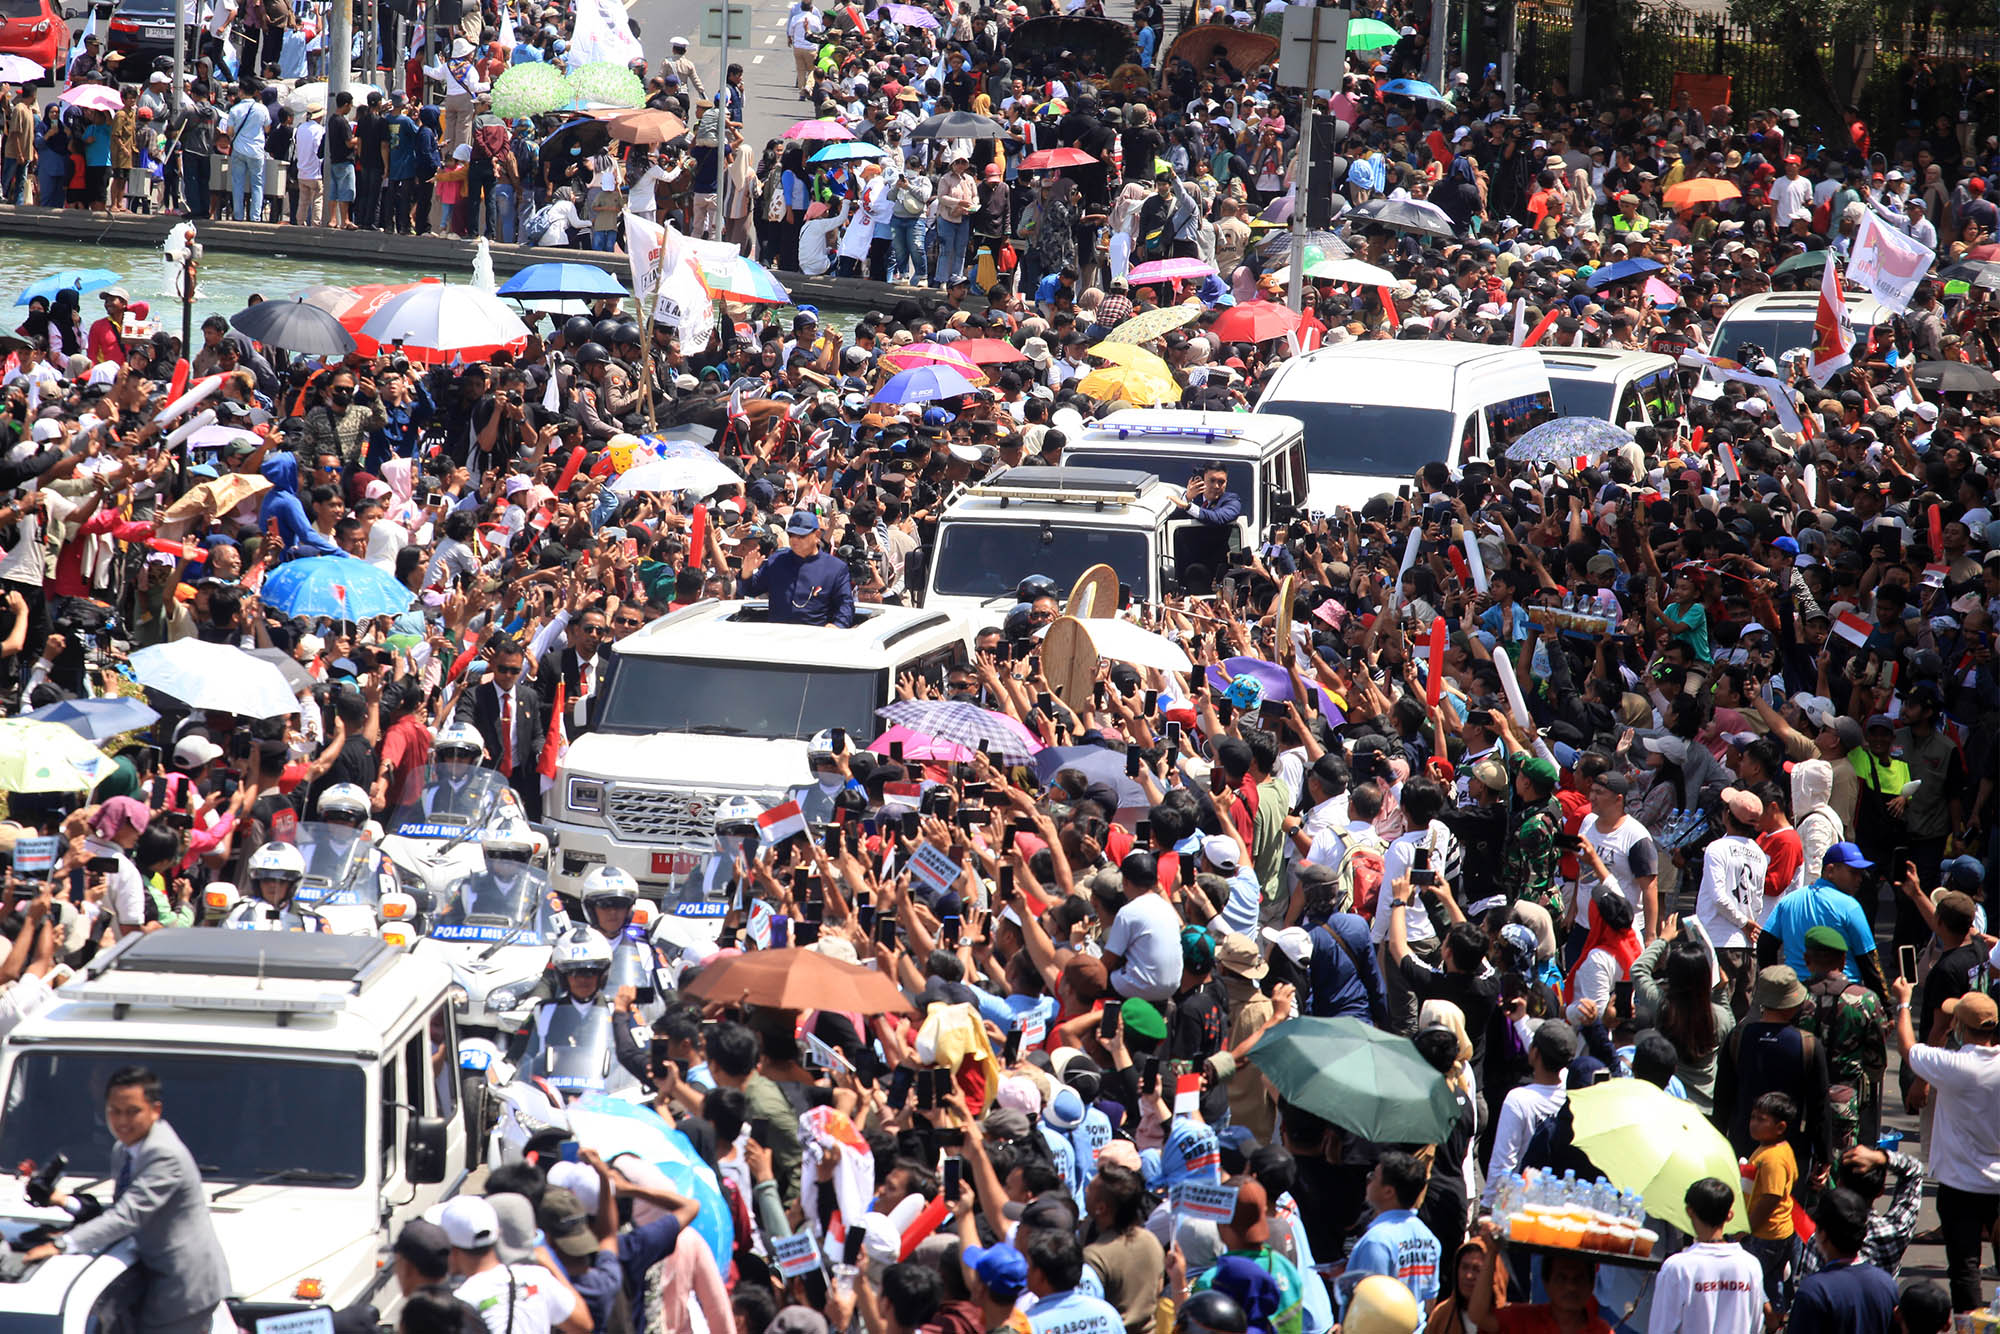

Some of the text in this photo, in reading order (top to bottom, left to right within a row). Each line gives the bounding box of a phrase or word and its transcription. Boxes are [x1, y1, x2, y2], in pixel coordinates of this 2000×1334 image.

[398, 823, 440, 837] POLISI
[677, 903, 721, 915] POLISI
[434, 926, 479, 939] POLISI
[1184, 1185, 1235, 1199] PRABOWO
[1184, 1193, 1222, 1205] GIBRAN
[1695, 1280, 1752, 1293] GERINDRA
